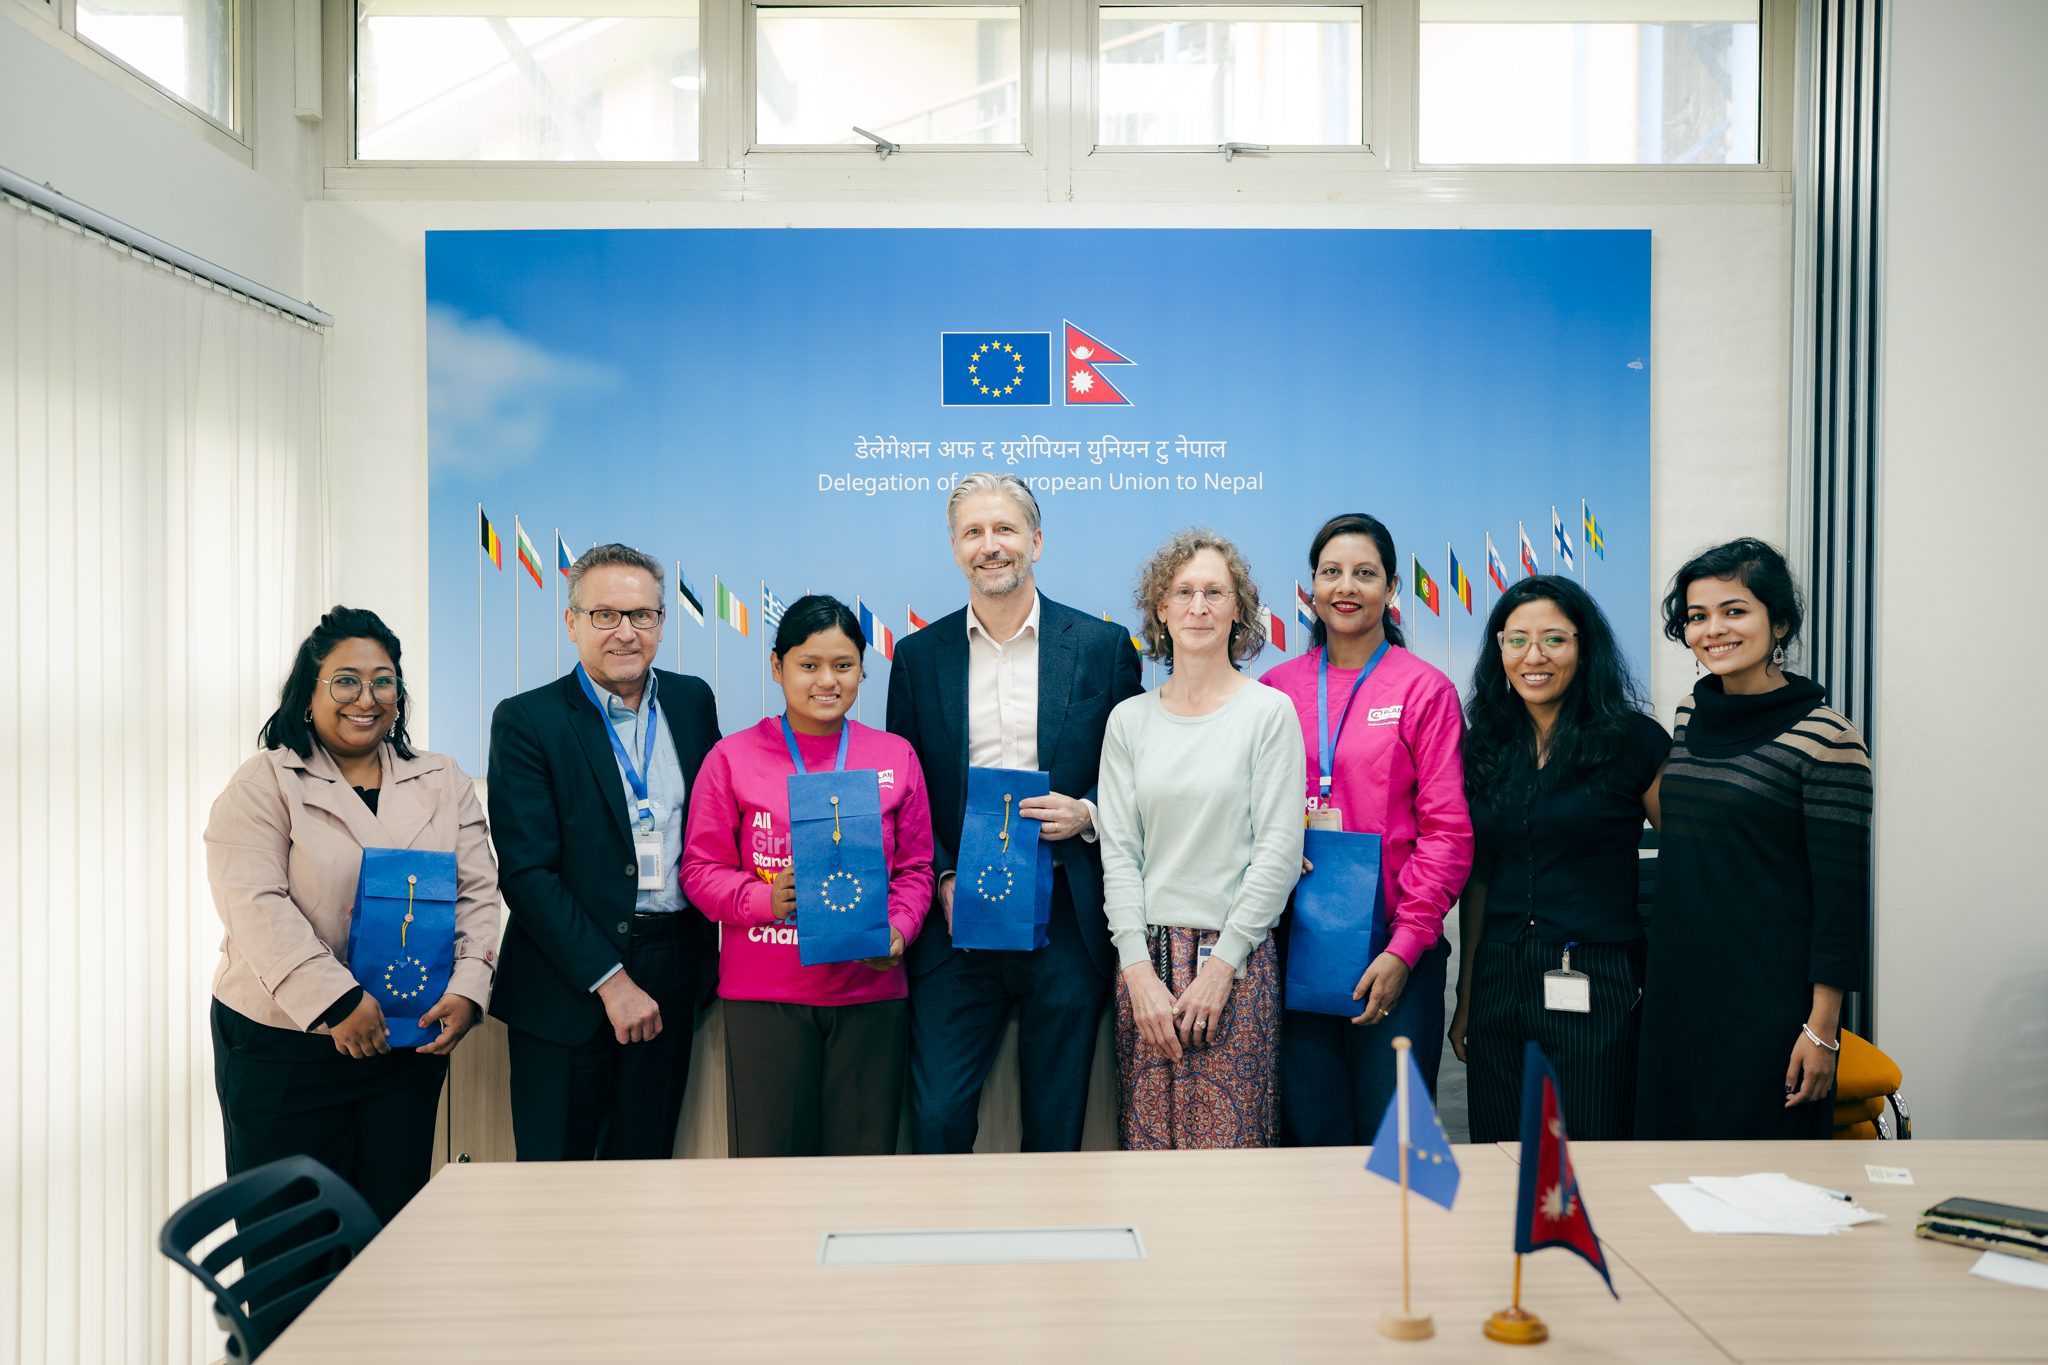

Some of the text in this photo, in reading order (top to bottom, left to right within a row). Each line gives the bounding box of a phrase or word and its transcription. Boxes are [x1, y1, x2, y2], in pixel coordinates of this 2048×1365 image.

[854, 434, 1228, 465] डेलेगेशन अफ द यूरोपियन युनियन टु नेपाल
[818, 472, 930, 496] Delegation
[937, 472, 958, 491] of
[1109, 472, 1170, 491] Union
[1176, 474, 1197, 491] to
[1204, 471, 1264, 496] Nepal
[752, 812, 771, 829] All
[751, 830, 792, 855] Girl
[752, 852, 793, 868] Stand
